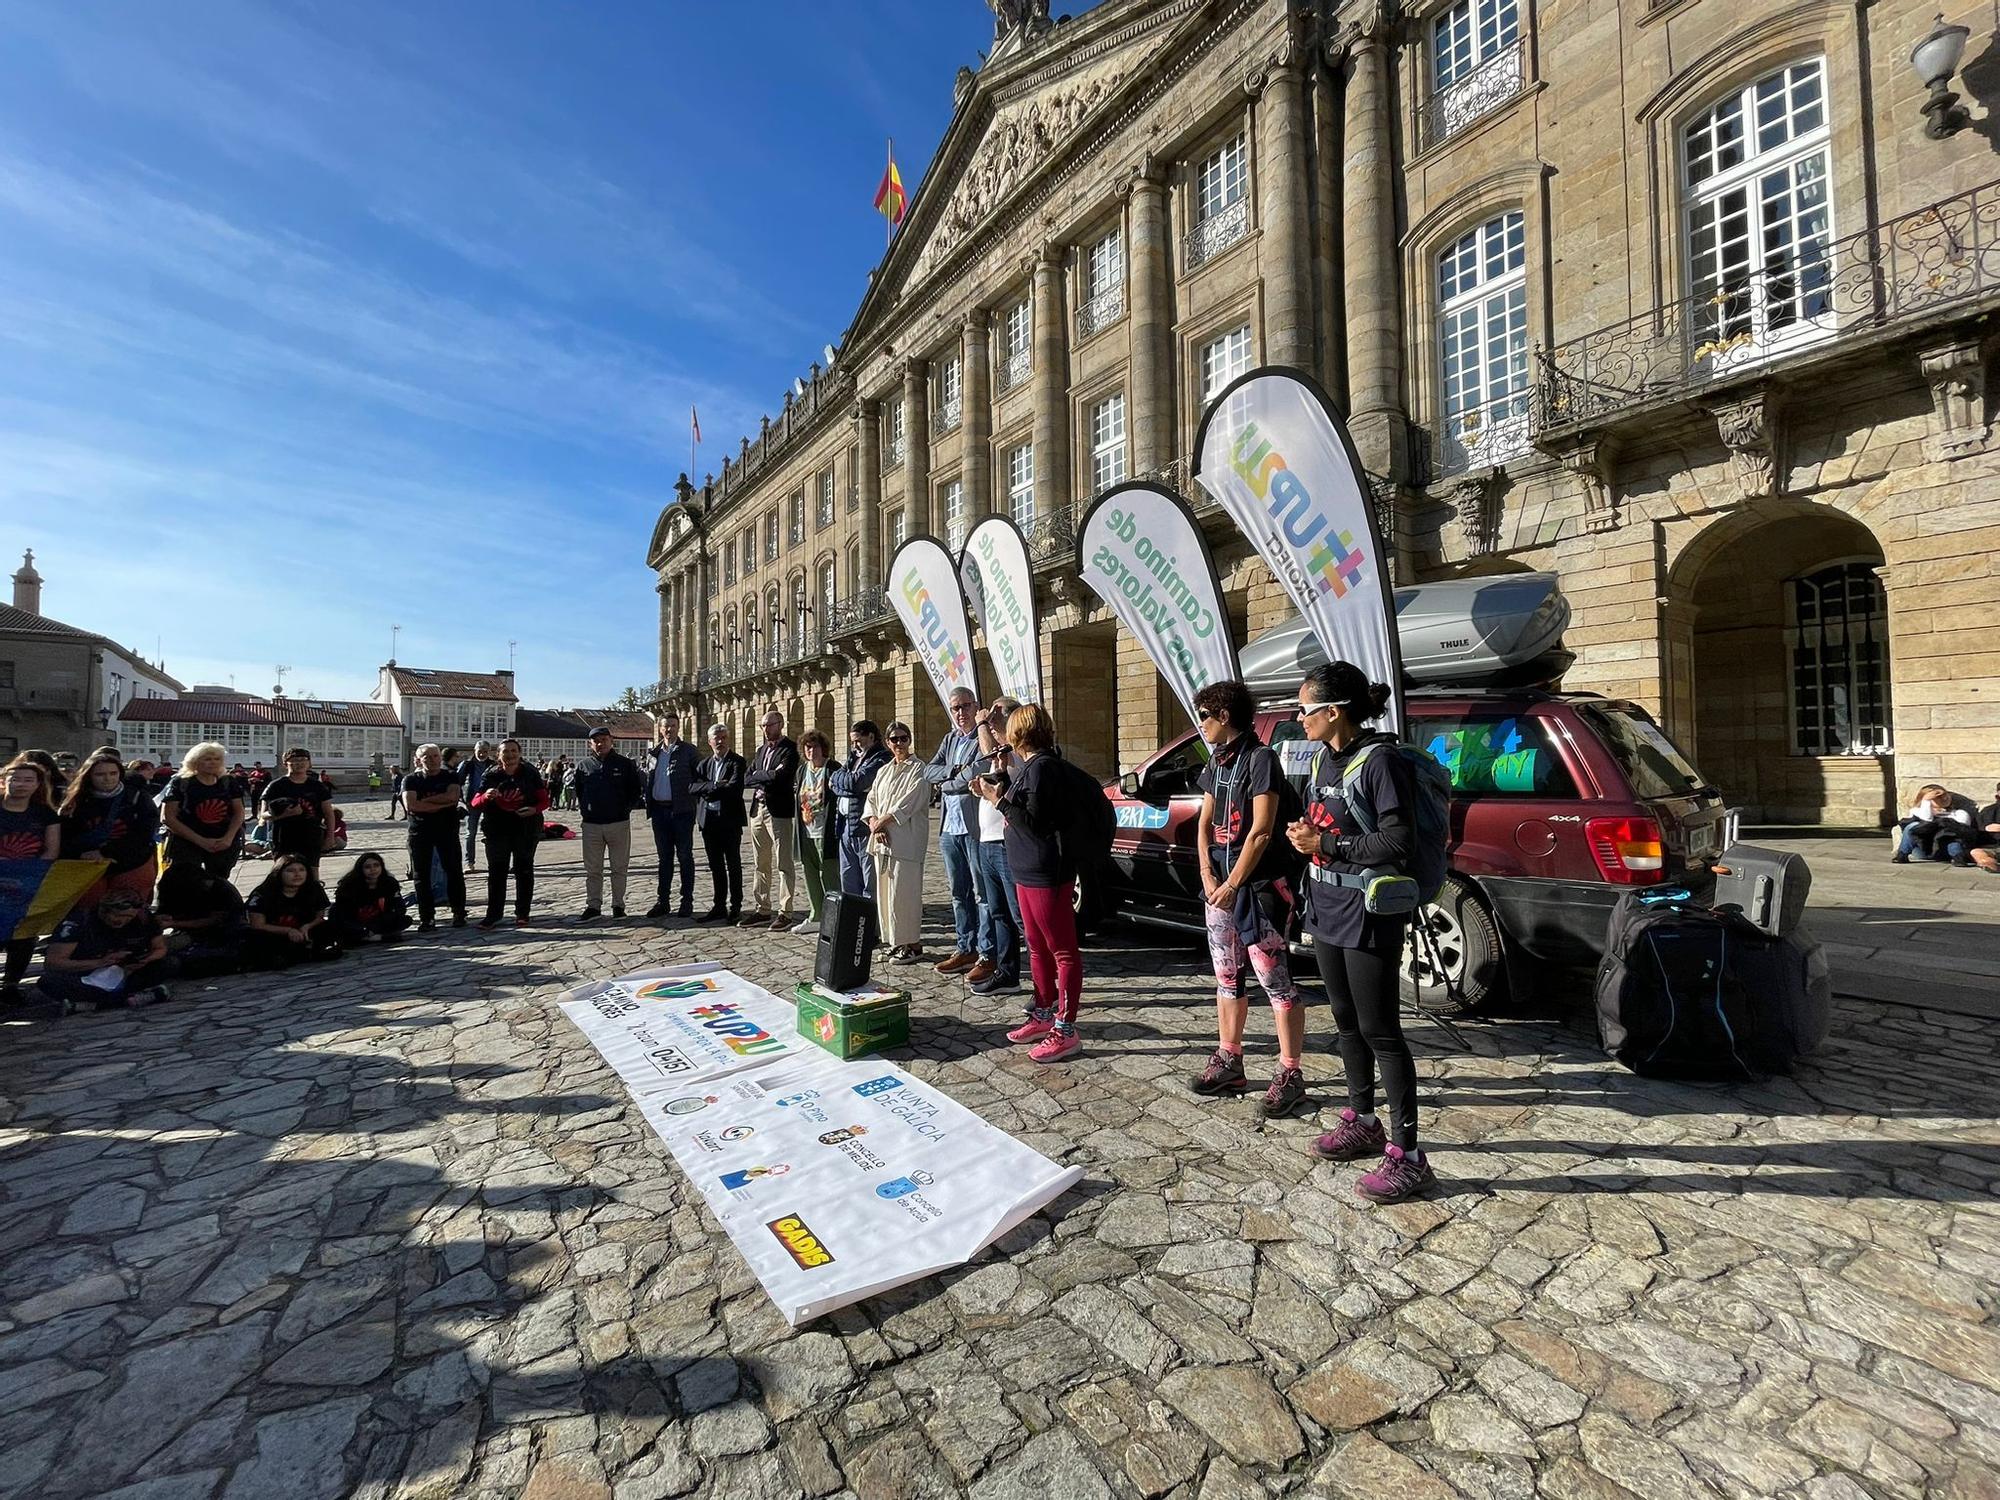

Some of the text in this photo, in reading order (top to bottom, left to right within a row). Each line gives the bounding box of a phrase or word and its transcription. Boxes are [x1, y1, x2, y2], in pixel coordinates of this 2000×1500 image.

[1440, 638, 1470, 649] THULE
[687, 1003, 788, 1056] #UP2U
[892, 1088, 940, 1118] XUNTA
[873, 1093, 947, 1143] DE GALICIA
[837, 1143, 875, 1172] DE MELIDE
[849, 1139, 886, 1168] CONCELLO
[896, 1198, 910, 1208] de
[910, 1192, 943, 1217] Concello
[778, 1217, 830, 1266] GADIS
